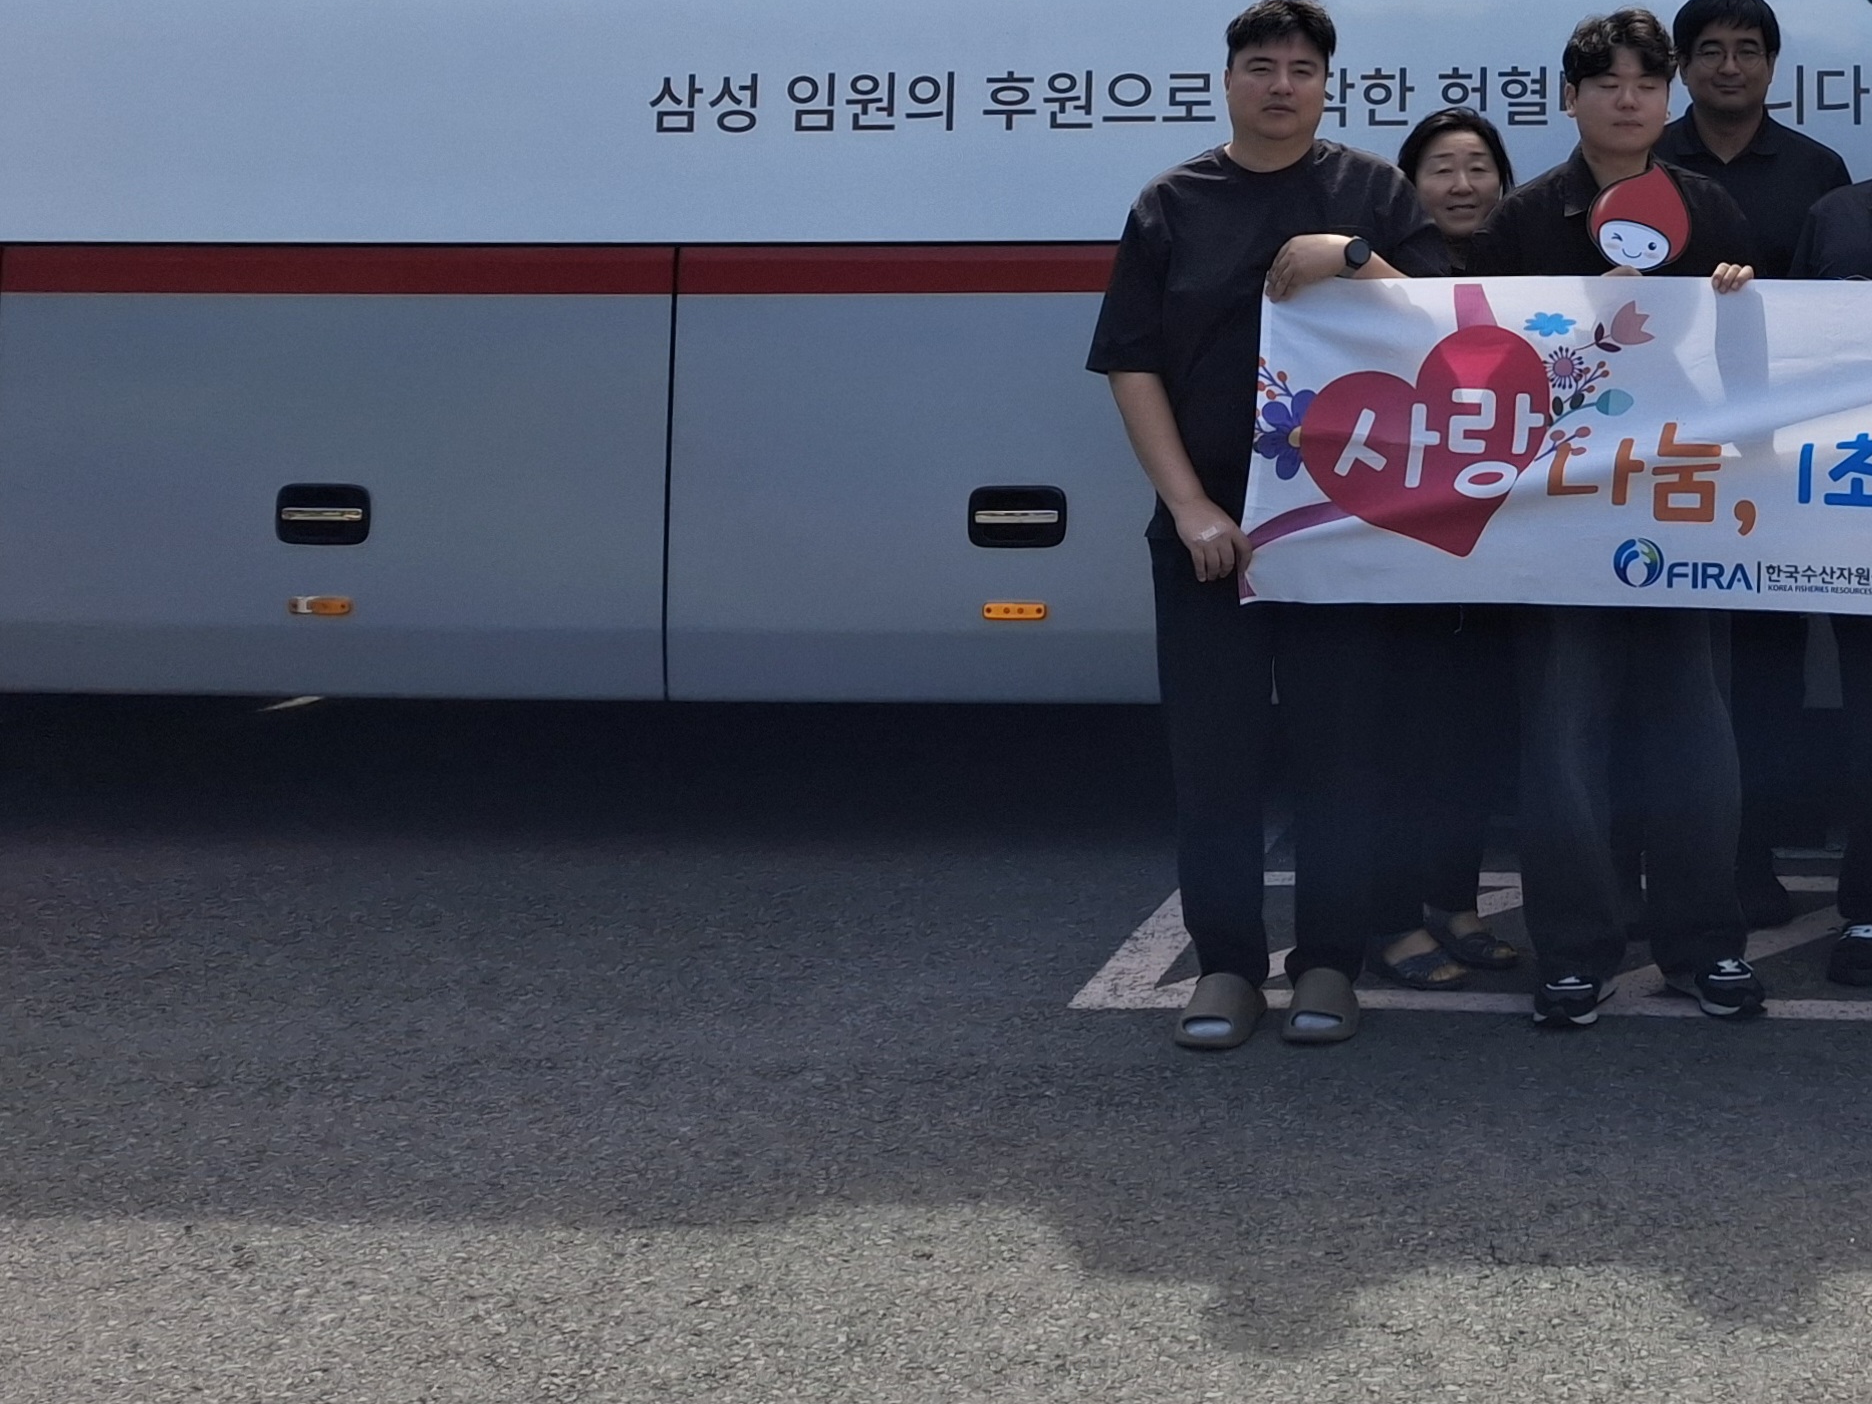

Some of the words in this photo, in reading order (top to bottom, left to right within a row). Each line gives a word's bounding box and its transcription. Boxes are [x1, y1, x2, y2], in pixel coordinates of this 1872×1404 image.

[648, 73, 759, 134] 삼성
[786, 71, 955, 133] 임원의
[981, 69, 1217, 131] 후원으로
[1666, 560, 1754, 591] FIRA
